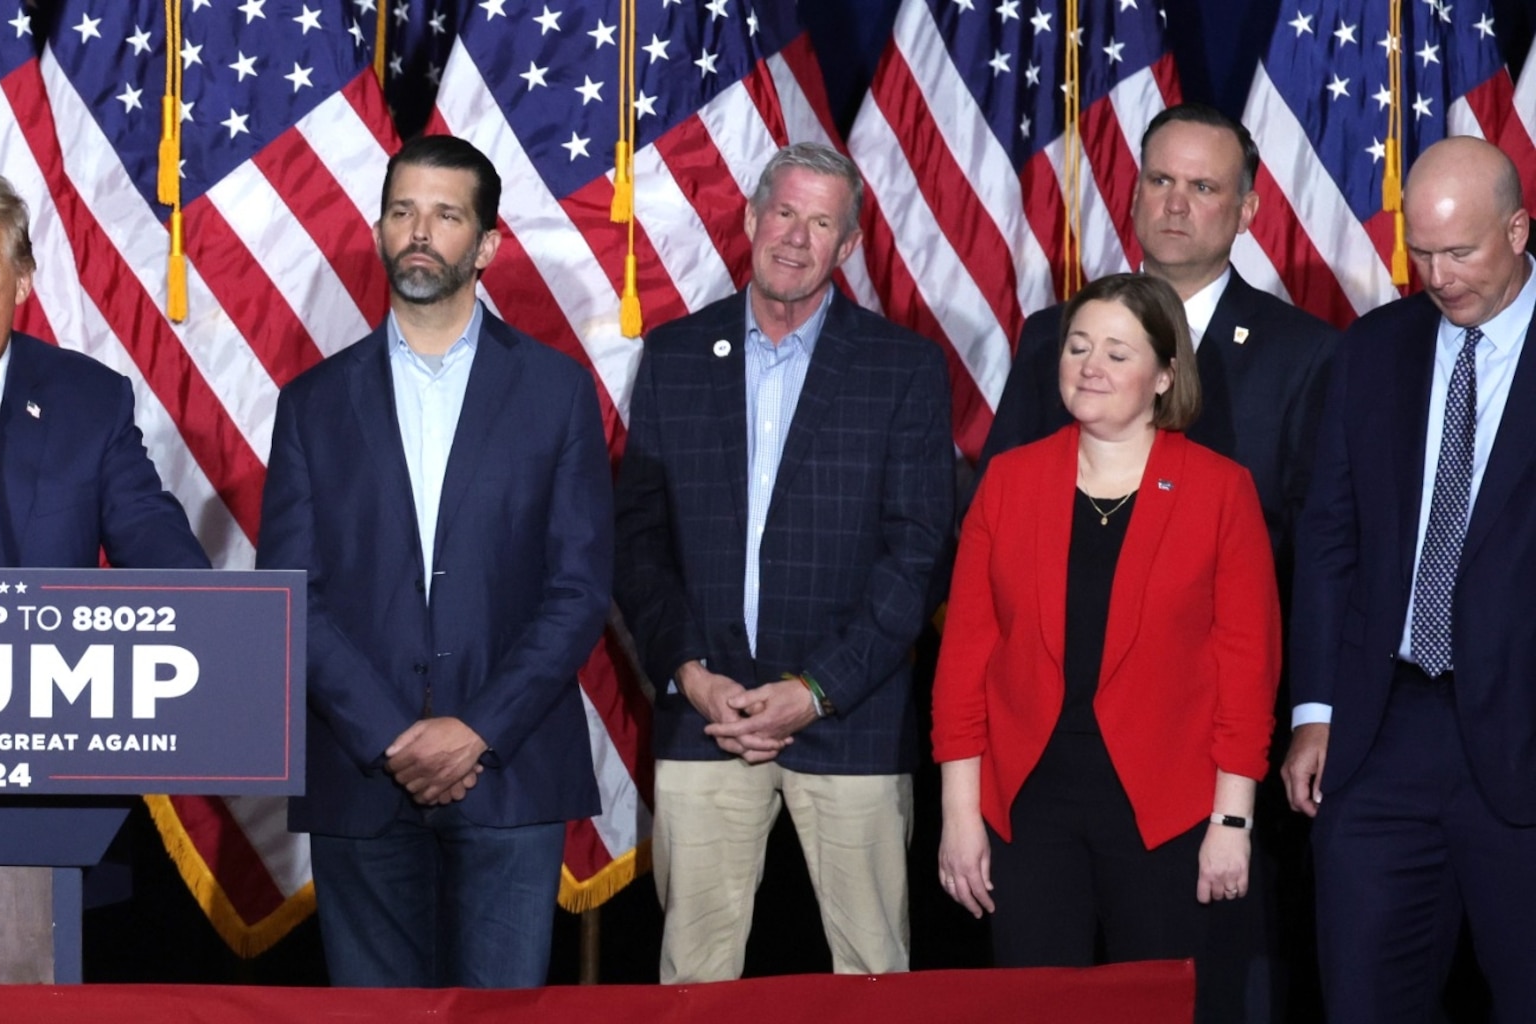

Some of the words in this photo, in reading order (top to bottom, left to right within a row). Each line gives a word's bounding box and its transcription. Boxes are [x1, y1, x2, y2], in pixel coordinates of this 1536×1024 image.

[17, 605, 62, 632] TO
[72, 605, 177, 632] 88022
[87, 733, 177, 752] AGAIN!
